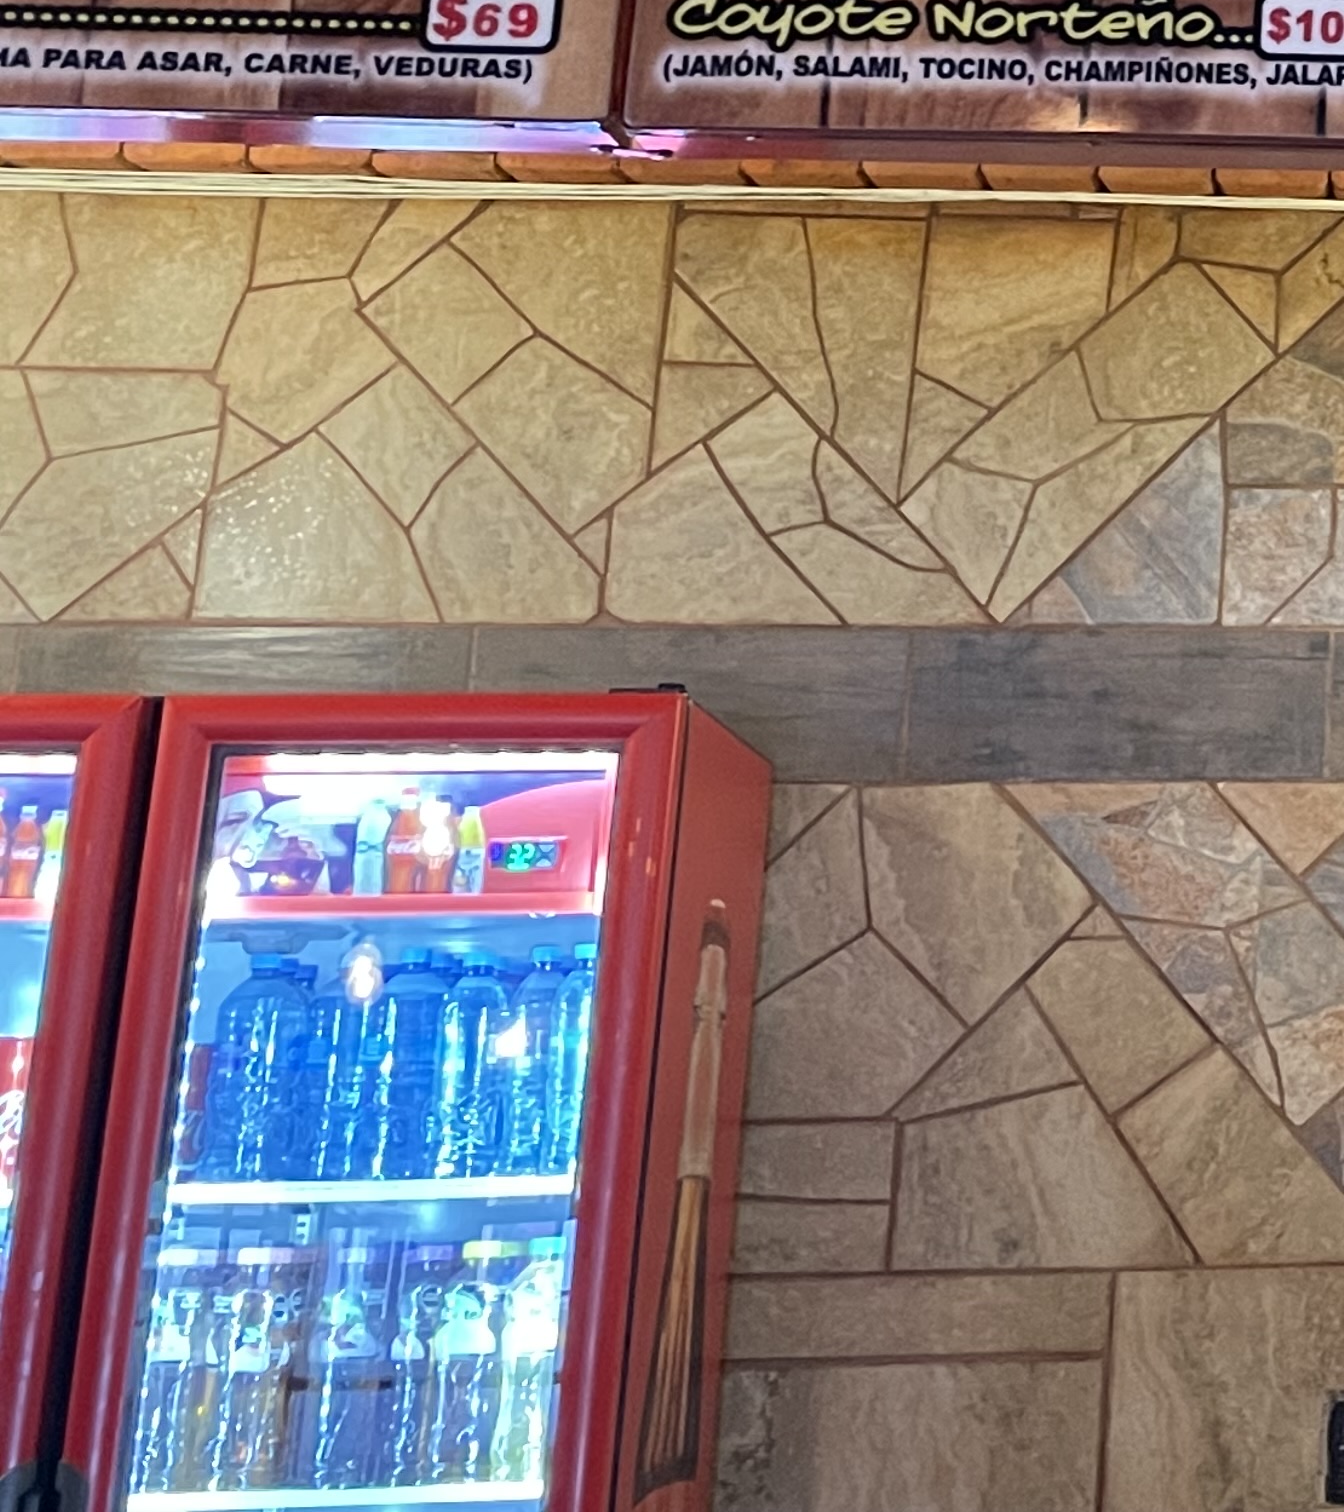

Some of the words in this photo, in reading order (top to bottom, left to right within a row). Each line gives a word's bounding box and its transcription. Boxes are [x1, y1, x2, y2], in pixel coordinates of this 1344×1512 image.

[42, 48, 127, 71] PARA
[136, 50, 232, 77] ASAR,
[244, 52, 361, 80] CARNE,
[373, 55, 533, 85] VEDURAS)
